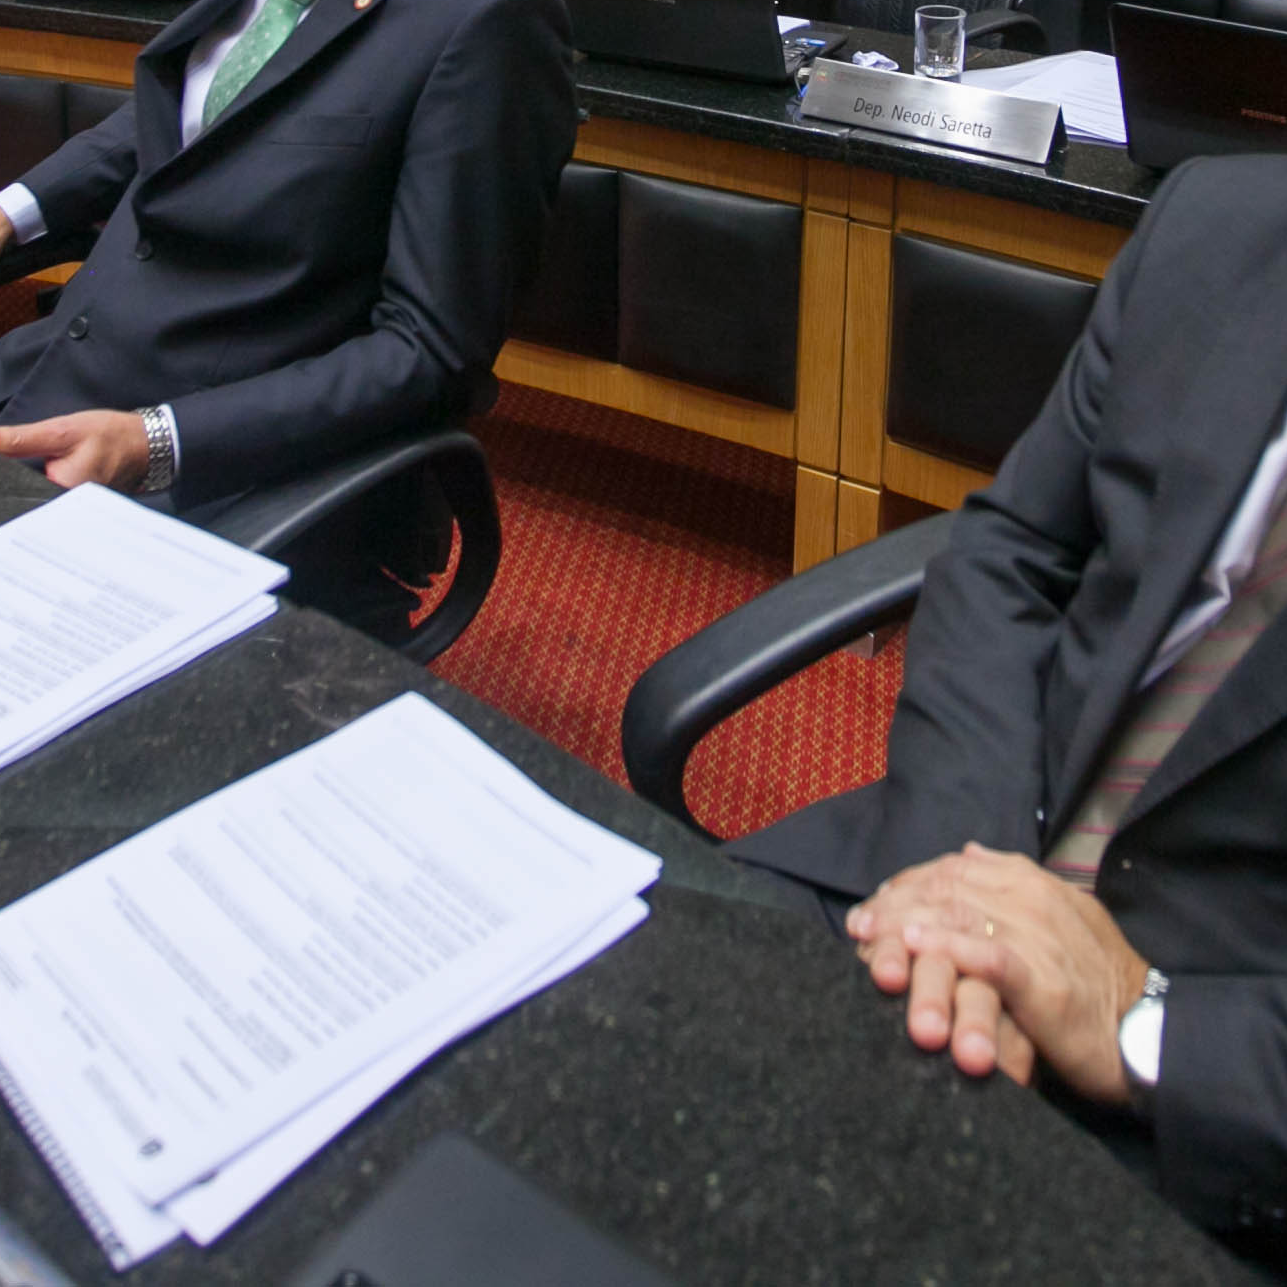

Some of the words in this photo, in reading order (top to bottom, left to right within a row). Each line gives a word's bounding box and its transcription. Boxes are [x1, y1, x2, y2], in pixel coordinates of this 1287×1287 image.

[853, 96, 886, 120] Dep.
[891, 104, 937, 128] Neodi
[939, 113, 993, 139] Saretta
